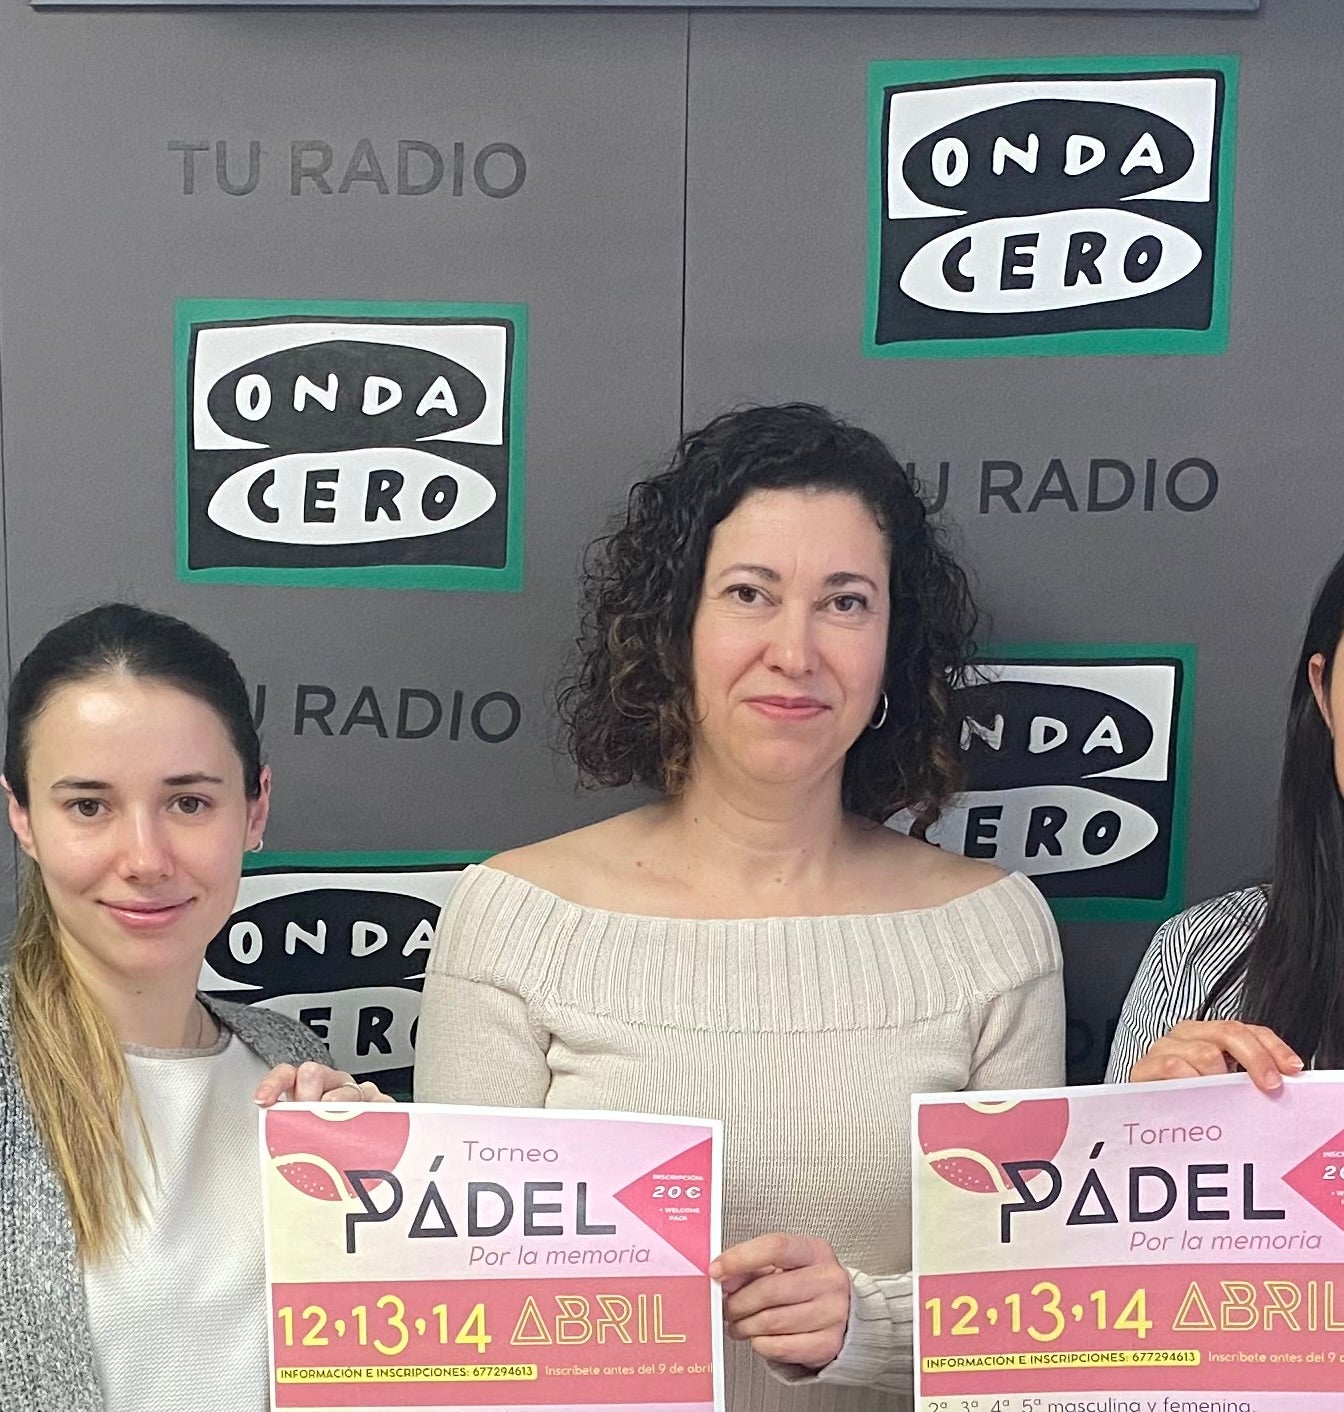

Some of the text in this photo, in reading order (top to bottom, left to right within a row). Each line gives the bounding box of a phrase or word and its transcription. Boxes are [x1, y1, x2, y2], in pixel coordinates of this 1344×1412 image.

[167, 138, 527, 199] TU RADIO
[931, 131, 1164, 187] ONDA
[942, 231, 1163, 293] CERO
[234, 372, 458, 421] ONDA
[247, 468, 459, 524] CERO
[978, 457, 1219, 514] RADIO
[293, 684, 522, 744] RADIO
[959, 715, 1124, 755] NDA
[963, 804, 1122, 858] ERO
[229, 919, 436, 964] ONDA
[463, 1140, 559, 1163] Torneo
[1123, 1123, 1222, 1145] Torneo
[343, 1155, 617, 1254] PÁDEL
[1001, 1141, 1286, 1244] PÁDEL
[469, 1244, 650, 1266] Por la memoria
[1130, 1230, 1322, 1251] Por la memoria
[509, 1293, 687, 1346] ABRIL
[280, 1366, 533, 1379] INFORMACIÓN E INSCRIPCIONES: 677294613
[603, 1365, 635, 1375] antes
[637, 1363, 656, 1375] del
[658, 1363, 666, 1374] 9
[669, 1362, 684, 1374] de
[687, 1362, 713, 1374] abril
[927, 1352, 1196, 1369] INFORMACIÓN E INSCRIPCIONES: 677294613
[1269, 1352, 1303, 1363] antes
[1305, 1352, 1325, 1363] del
[1327, 1352, 1336, 1363] 9
